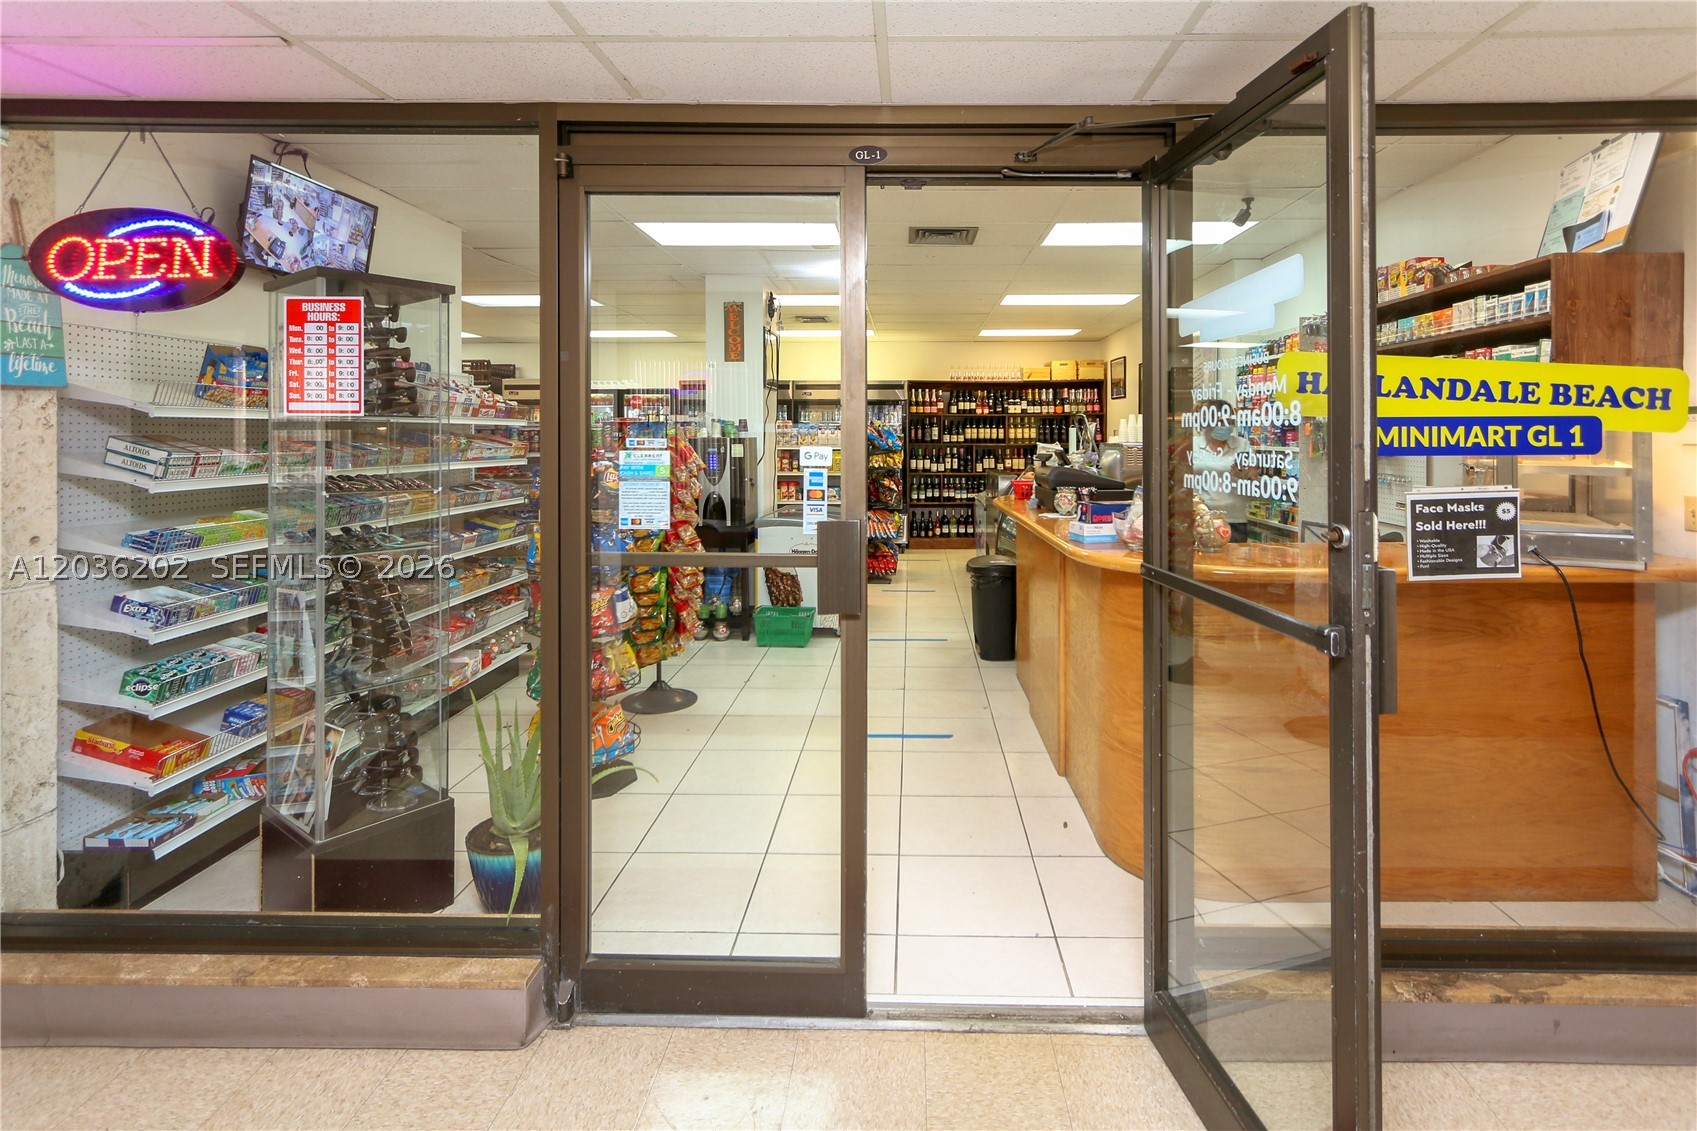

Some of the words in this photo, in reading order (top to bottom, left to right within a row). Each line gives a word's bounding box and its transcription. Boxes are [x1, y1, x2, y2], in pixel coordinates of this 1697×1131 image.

[46, 236, 216, 281] OPEN
[7, 287, 32, 301] MADE
[37, 293, 49, 304] AT
[23, 305, 37, 315] THE
[302, 302, 346, 312] BUSINESS
[307, 312, 341, 322] HOURS:
[16, 337, 38, 350] LAST
[1296, 371, 1541, 406] HLANDALE
[1549, 381, 1673, 411] BEACH
[1377, 424, 1522, 448] MINIMART
[1527, 424, 1562, 448] GL
[1569, 424, 1584, 448] 1
[124, 444, 151, 457] ALTOIDS
[804, 451, 812, 460] G
[814, 451, 828, 462] Pay
[121, 458, 147, 471] ALTOIDS
[1415, 503, 1444, 514] Face
[1447, 502, 1485, 513] Masks
[1415, 521, 1443, 532] Sold
[1446, 520, 1487, 531] Here!!!
[123, 602, 148, 614] Extra
[125, 682, 159, 692] eclipse
